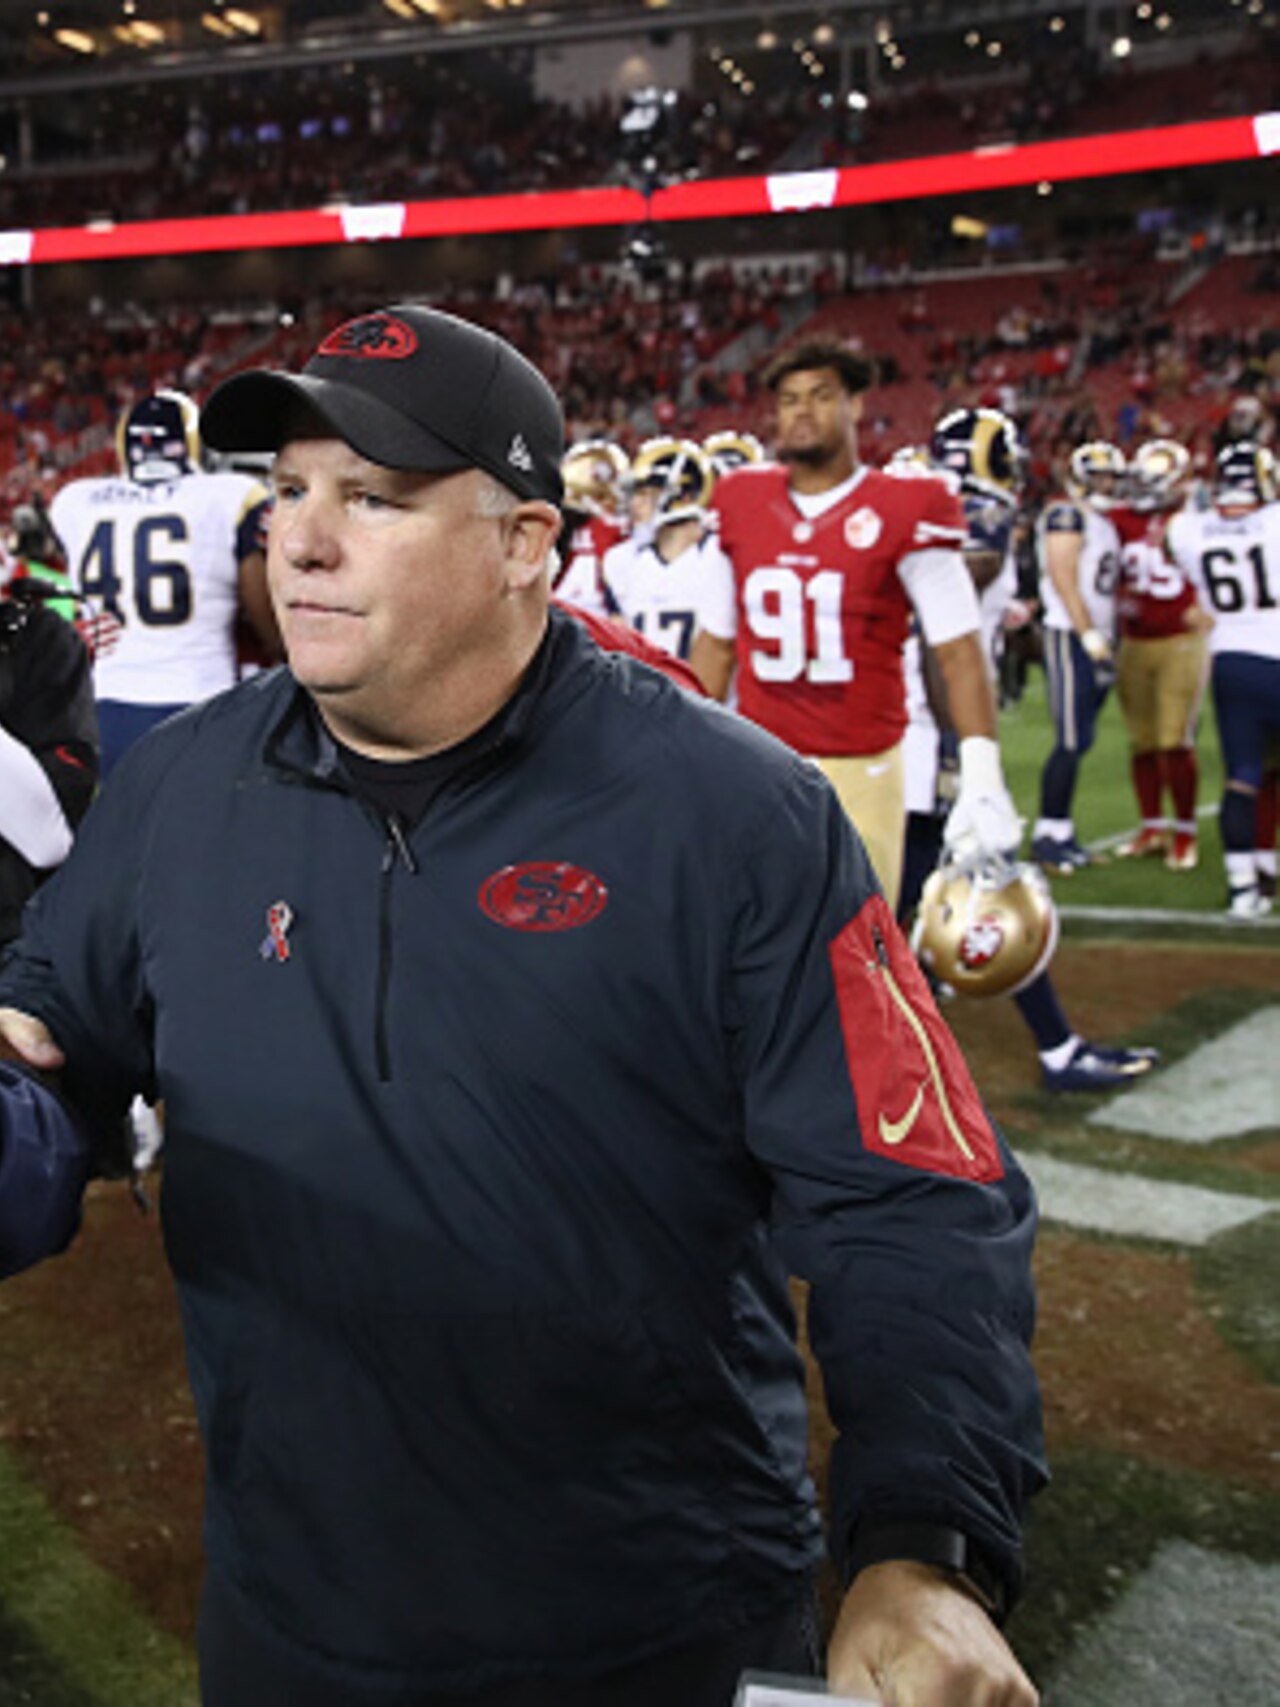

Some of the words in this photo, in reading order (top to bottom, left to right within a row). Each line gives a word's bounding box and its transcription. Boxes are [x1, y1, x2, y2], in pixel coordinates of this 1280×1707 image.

[80, 513, 193, 627] 46
[743, 566, 854, 683] 91
[1202, 545, 1276, 613] 61
